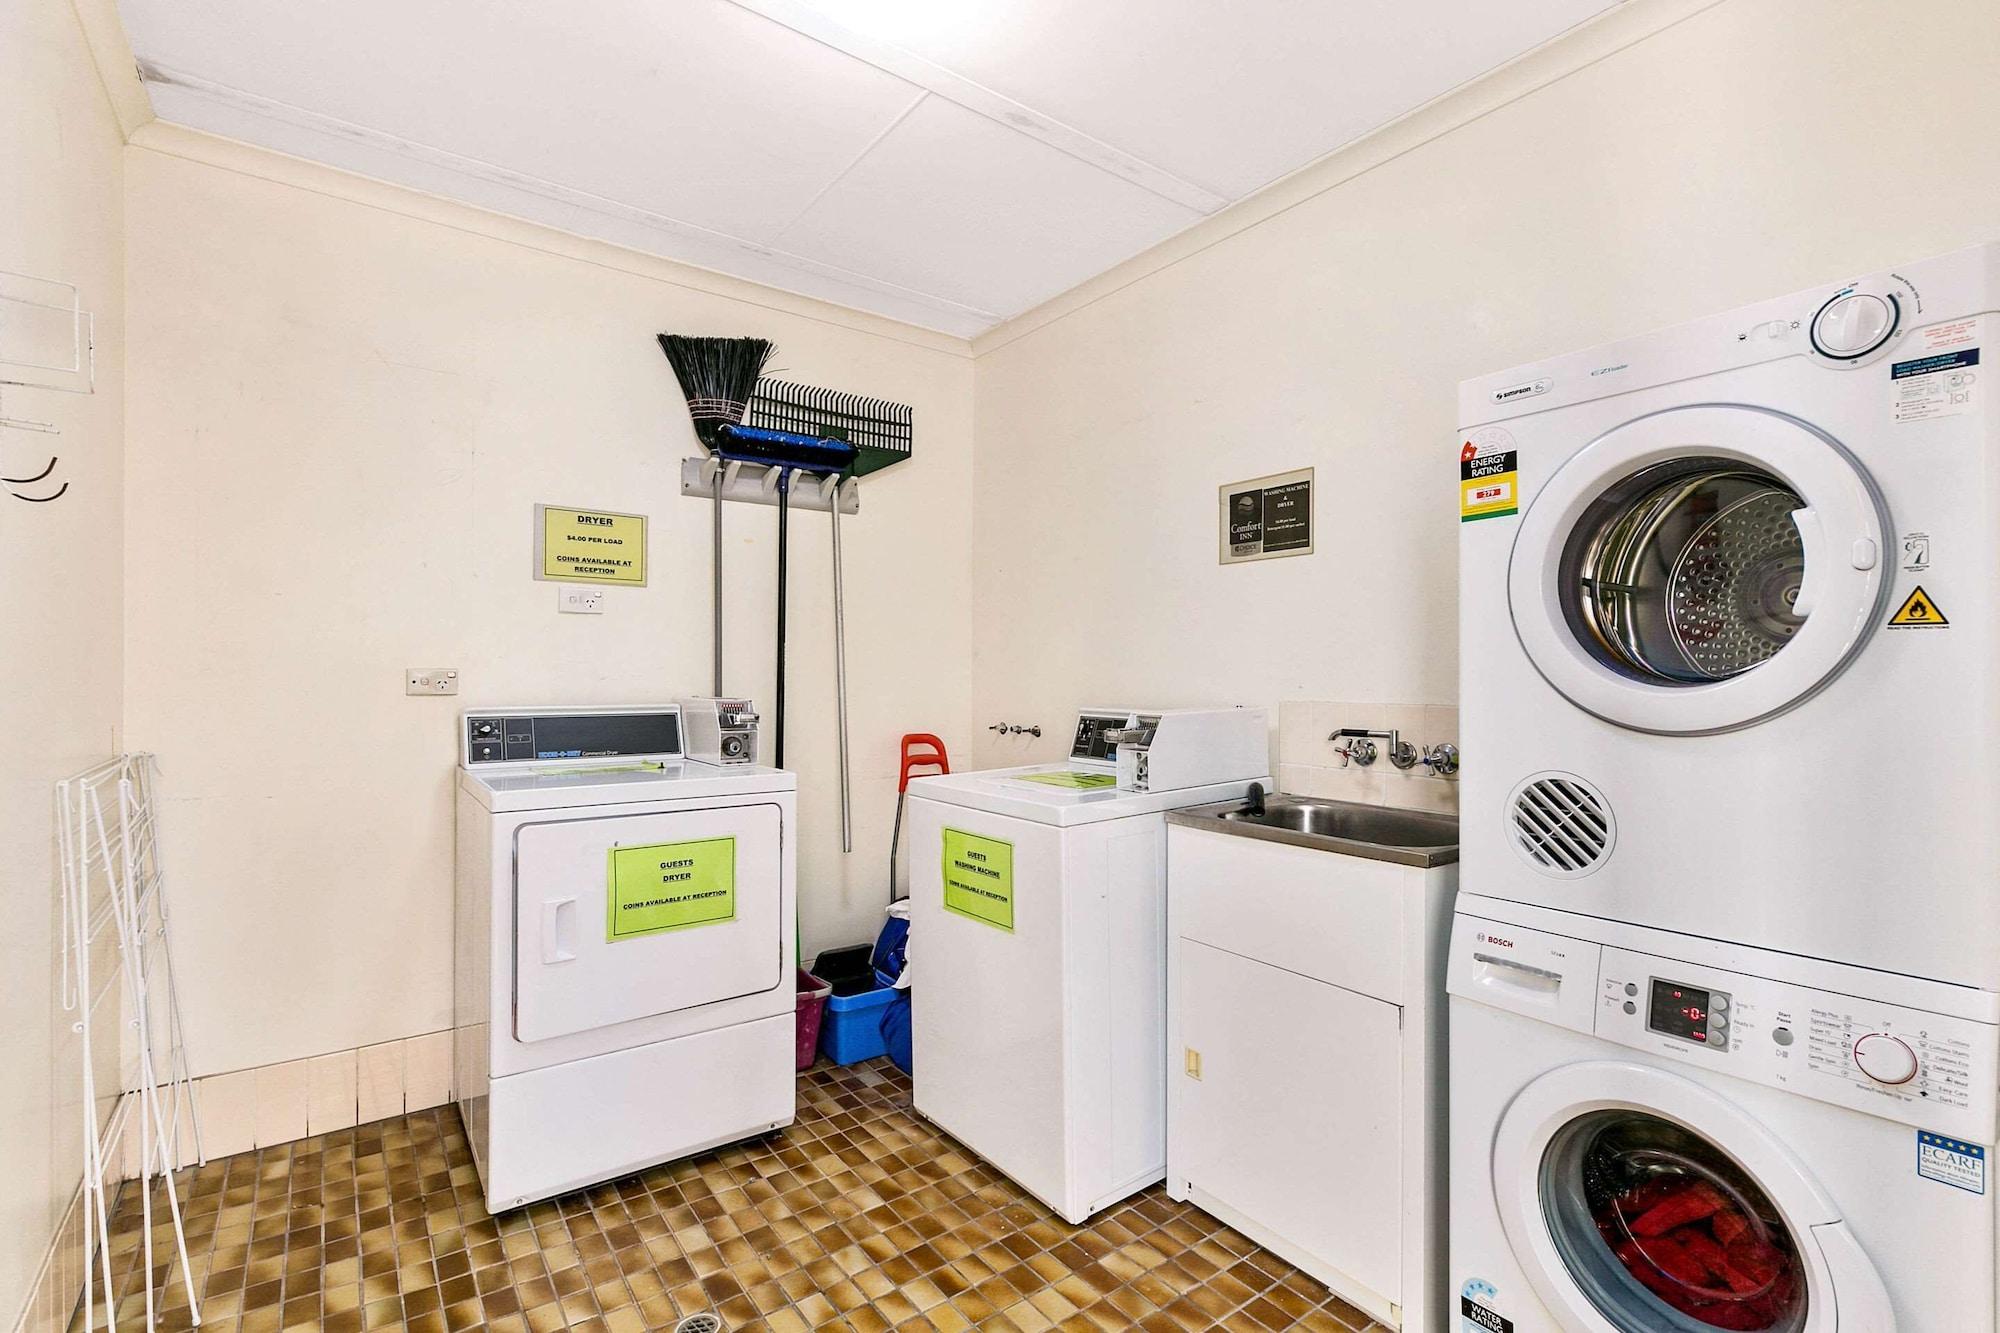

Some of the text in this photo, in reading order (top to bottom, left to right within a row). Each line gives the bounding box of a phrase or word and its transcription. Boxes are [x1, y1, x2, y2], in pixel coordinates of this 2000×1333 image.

[1470, 454, 1507, 469] ENERGY
[1471, 464, 1504, 478] RATING
[1286, 483, 1309, 492] MACHINE
[577, 515, 614, 526] DRYER
[1230, 520, 1262, 534] Comfort
[1240, 532, 1253, 540] INN
[556, 555, 580, 563] COINS
[581, 558, 622, 566] AVAILABLE
[574, 566, 616, 574] RECEPTION
[967, 850, 986, 862] GUESTS
[660, 859, 694, 870] GUESTS
[954, 860, 1000, 878] WASHING MACHINE
[663, 872, 692, 882] DRYER
[949, 880, 960, 888] COINS
[960, 883, 979, 894] AVAILABLE
[986, 890, 1008, 902] RECEPTION
[623, 902, 645, 910] COINS
[646, 896, 681, 906] AVAILABLE
[692, 890, 728, 900] RECEPTION
[1488, 936, 1514, 948] BOSCH
[1776, 1016, 1792, 1024] Pause
[1921, 1145, 1981, 1170] ECARF
[1921, 1156, 1952, 1169] QUALITY
[1954, 1166, 1981, 1178] TESTED
[1471, 1303, 1502, 1326] WATER
[1471, 1310, 1504, 1333] RATING
